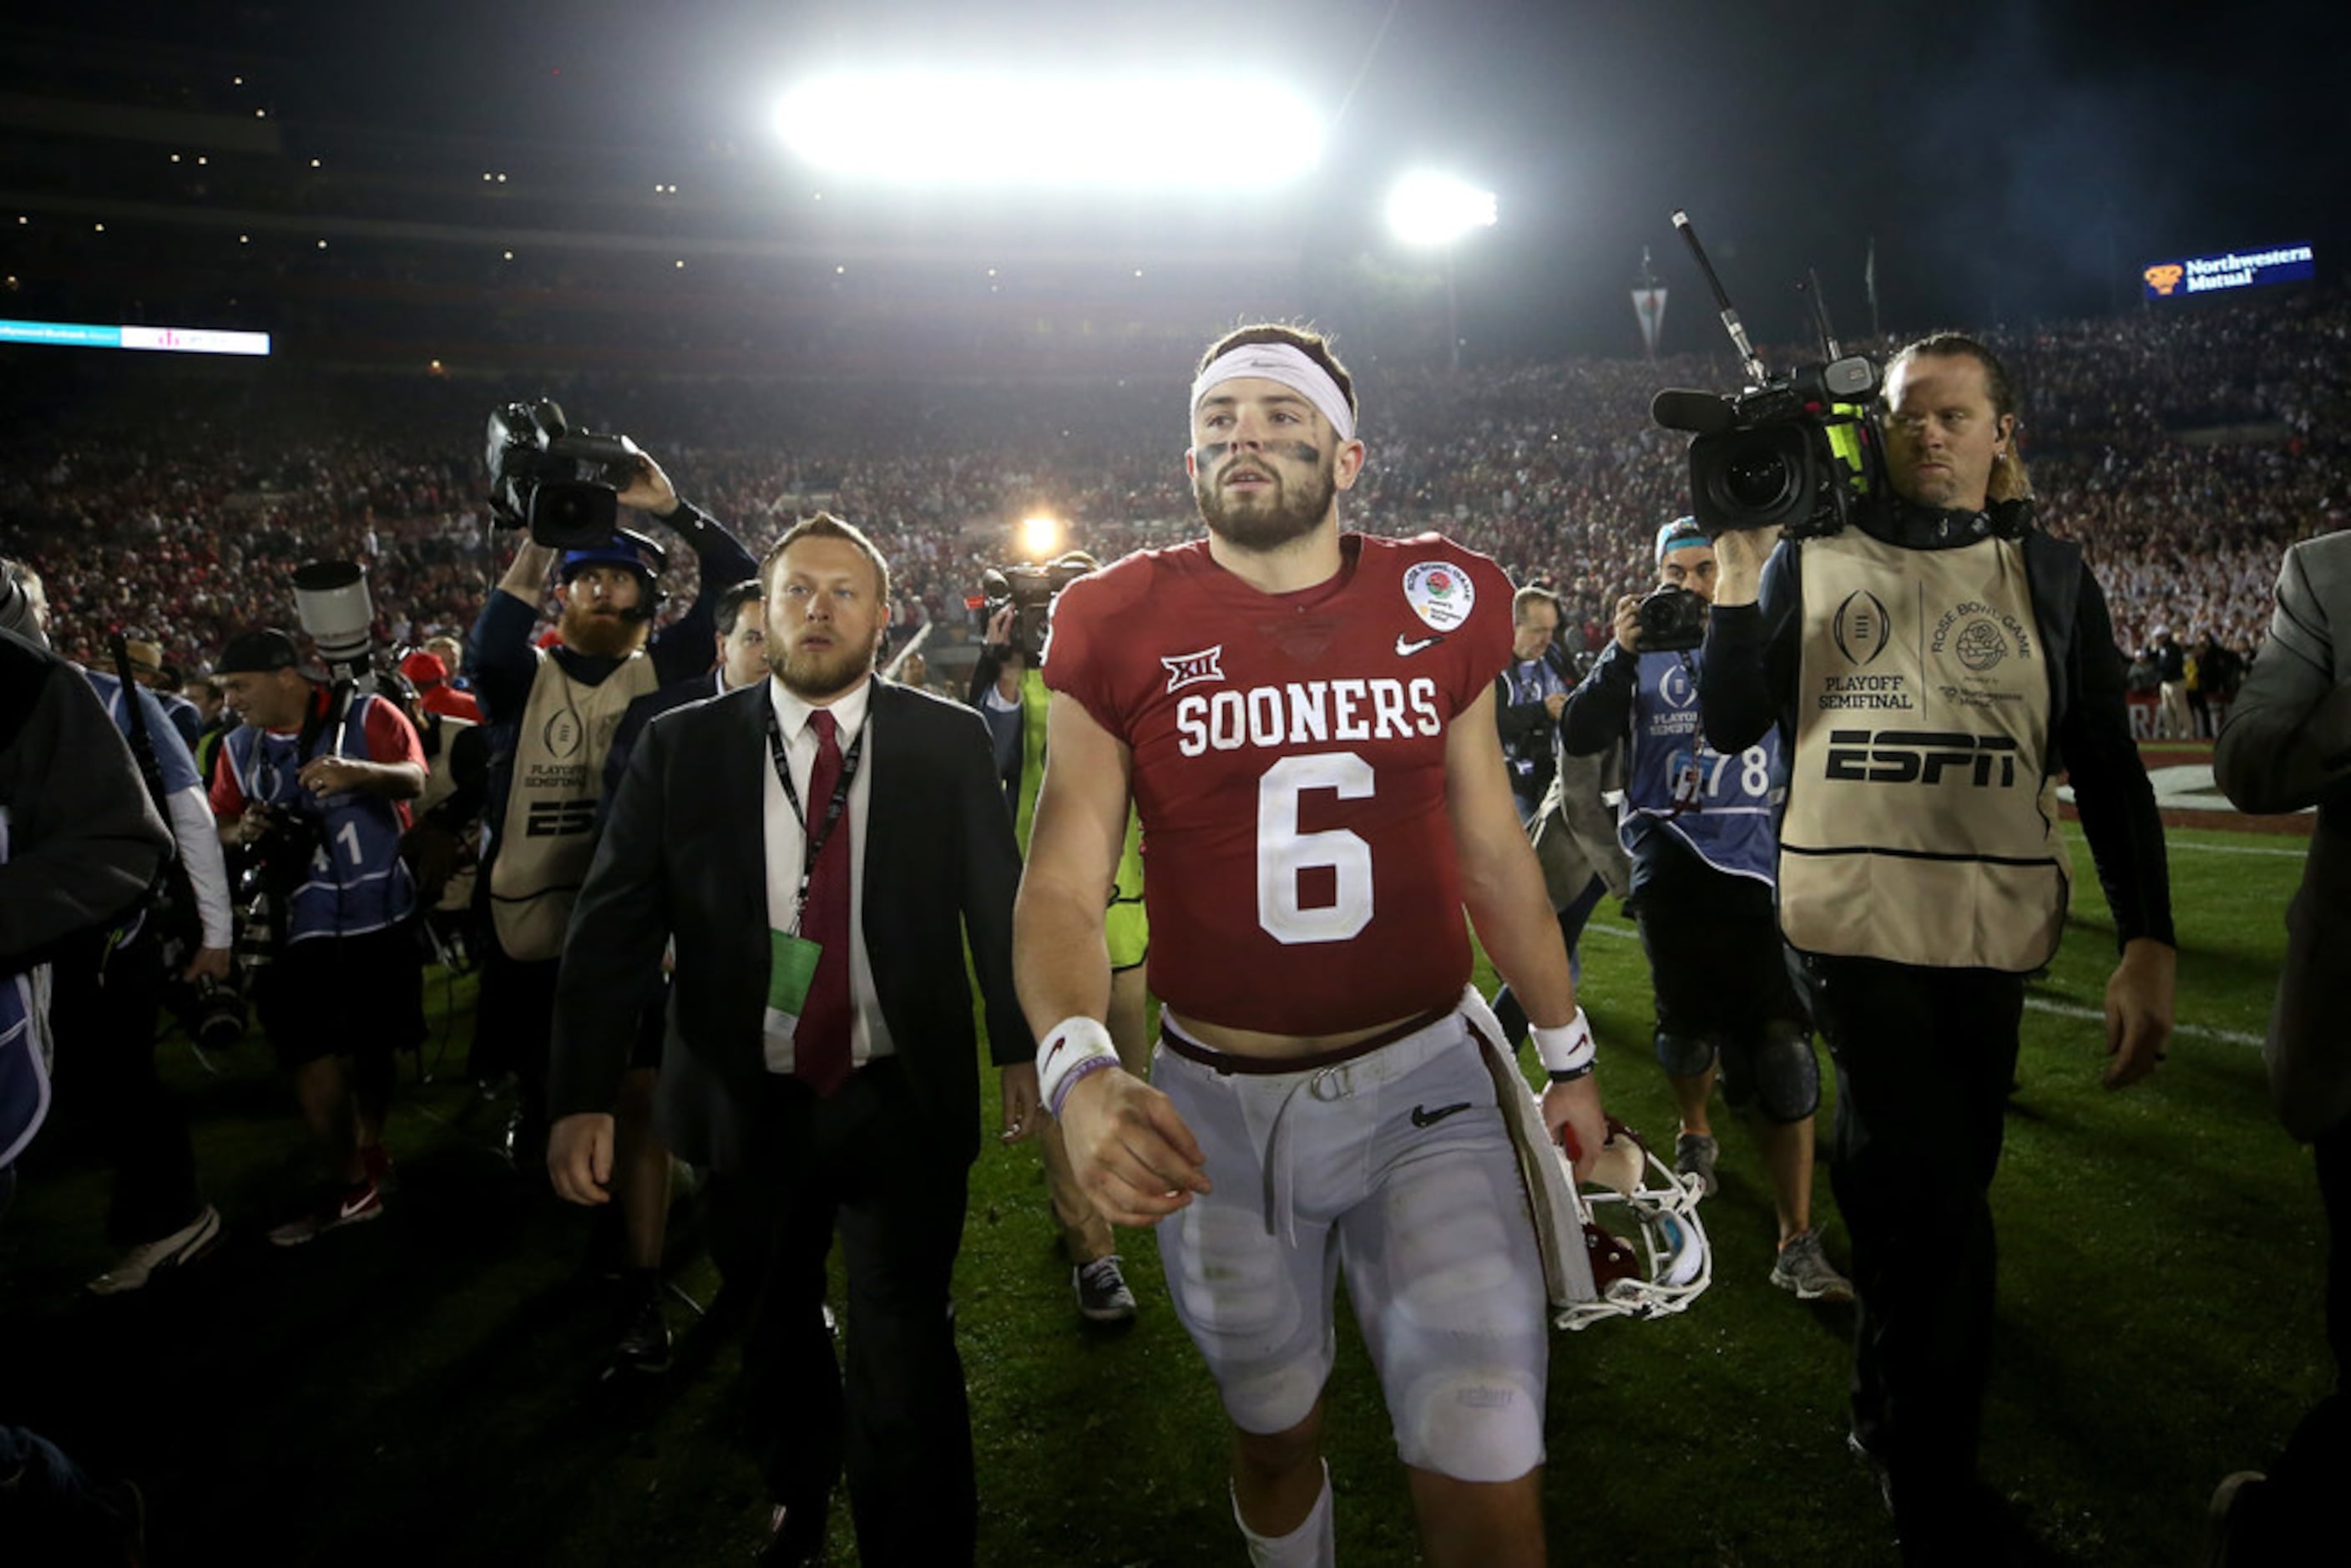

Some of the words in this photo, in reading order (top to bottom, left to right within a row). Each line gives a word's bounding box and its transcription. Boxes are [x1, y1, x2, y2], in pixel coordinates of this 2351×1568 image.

[2186, 246, 2313, 276] Northwestern
[2187, 268, 2253, 292] Mutual
[1931, 610, 1957, 652] ROSE
[2002, 615, 2030, 659] GAME
[1818, 693, 1913, 710] SEMIFINAL
[1825, 676, 1904, 692] PLAYOFF
[1176, 677, 1441, 757] SOONERS
[1825, 730, 2018, 787] ESPN
[1257, 752, 1375, 944] 6
